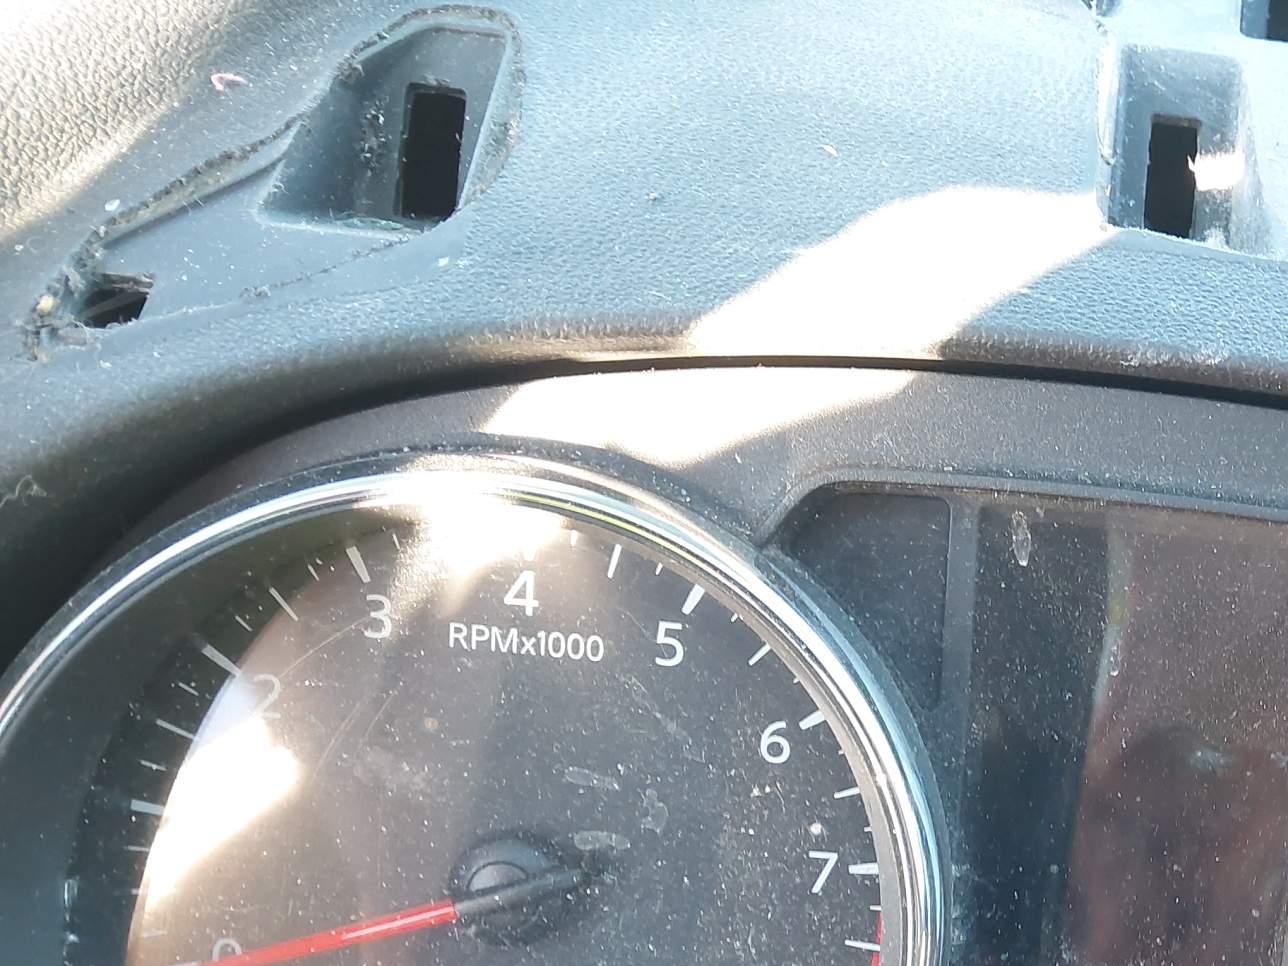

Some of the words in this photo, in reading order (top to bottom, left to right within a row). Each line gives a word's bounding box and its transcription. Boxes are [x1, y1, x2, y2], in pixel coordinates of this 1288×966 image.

[503, 570, 541, 617] 4
[363, 594, 393, 640] 3
[448, 621, 605, 662] RPMx1000
[655, 621, 685, 667] 5
[760, 720, 791, 764] 6
[808, 850, 839, 894] 7
